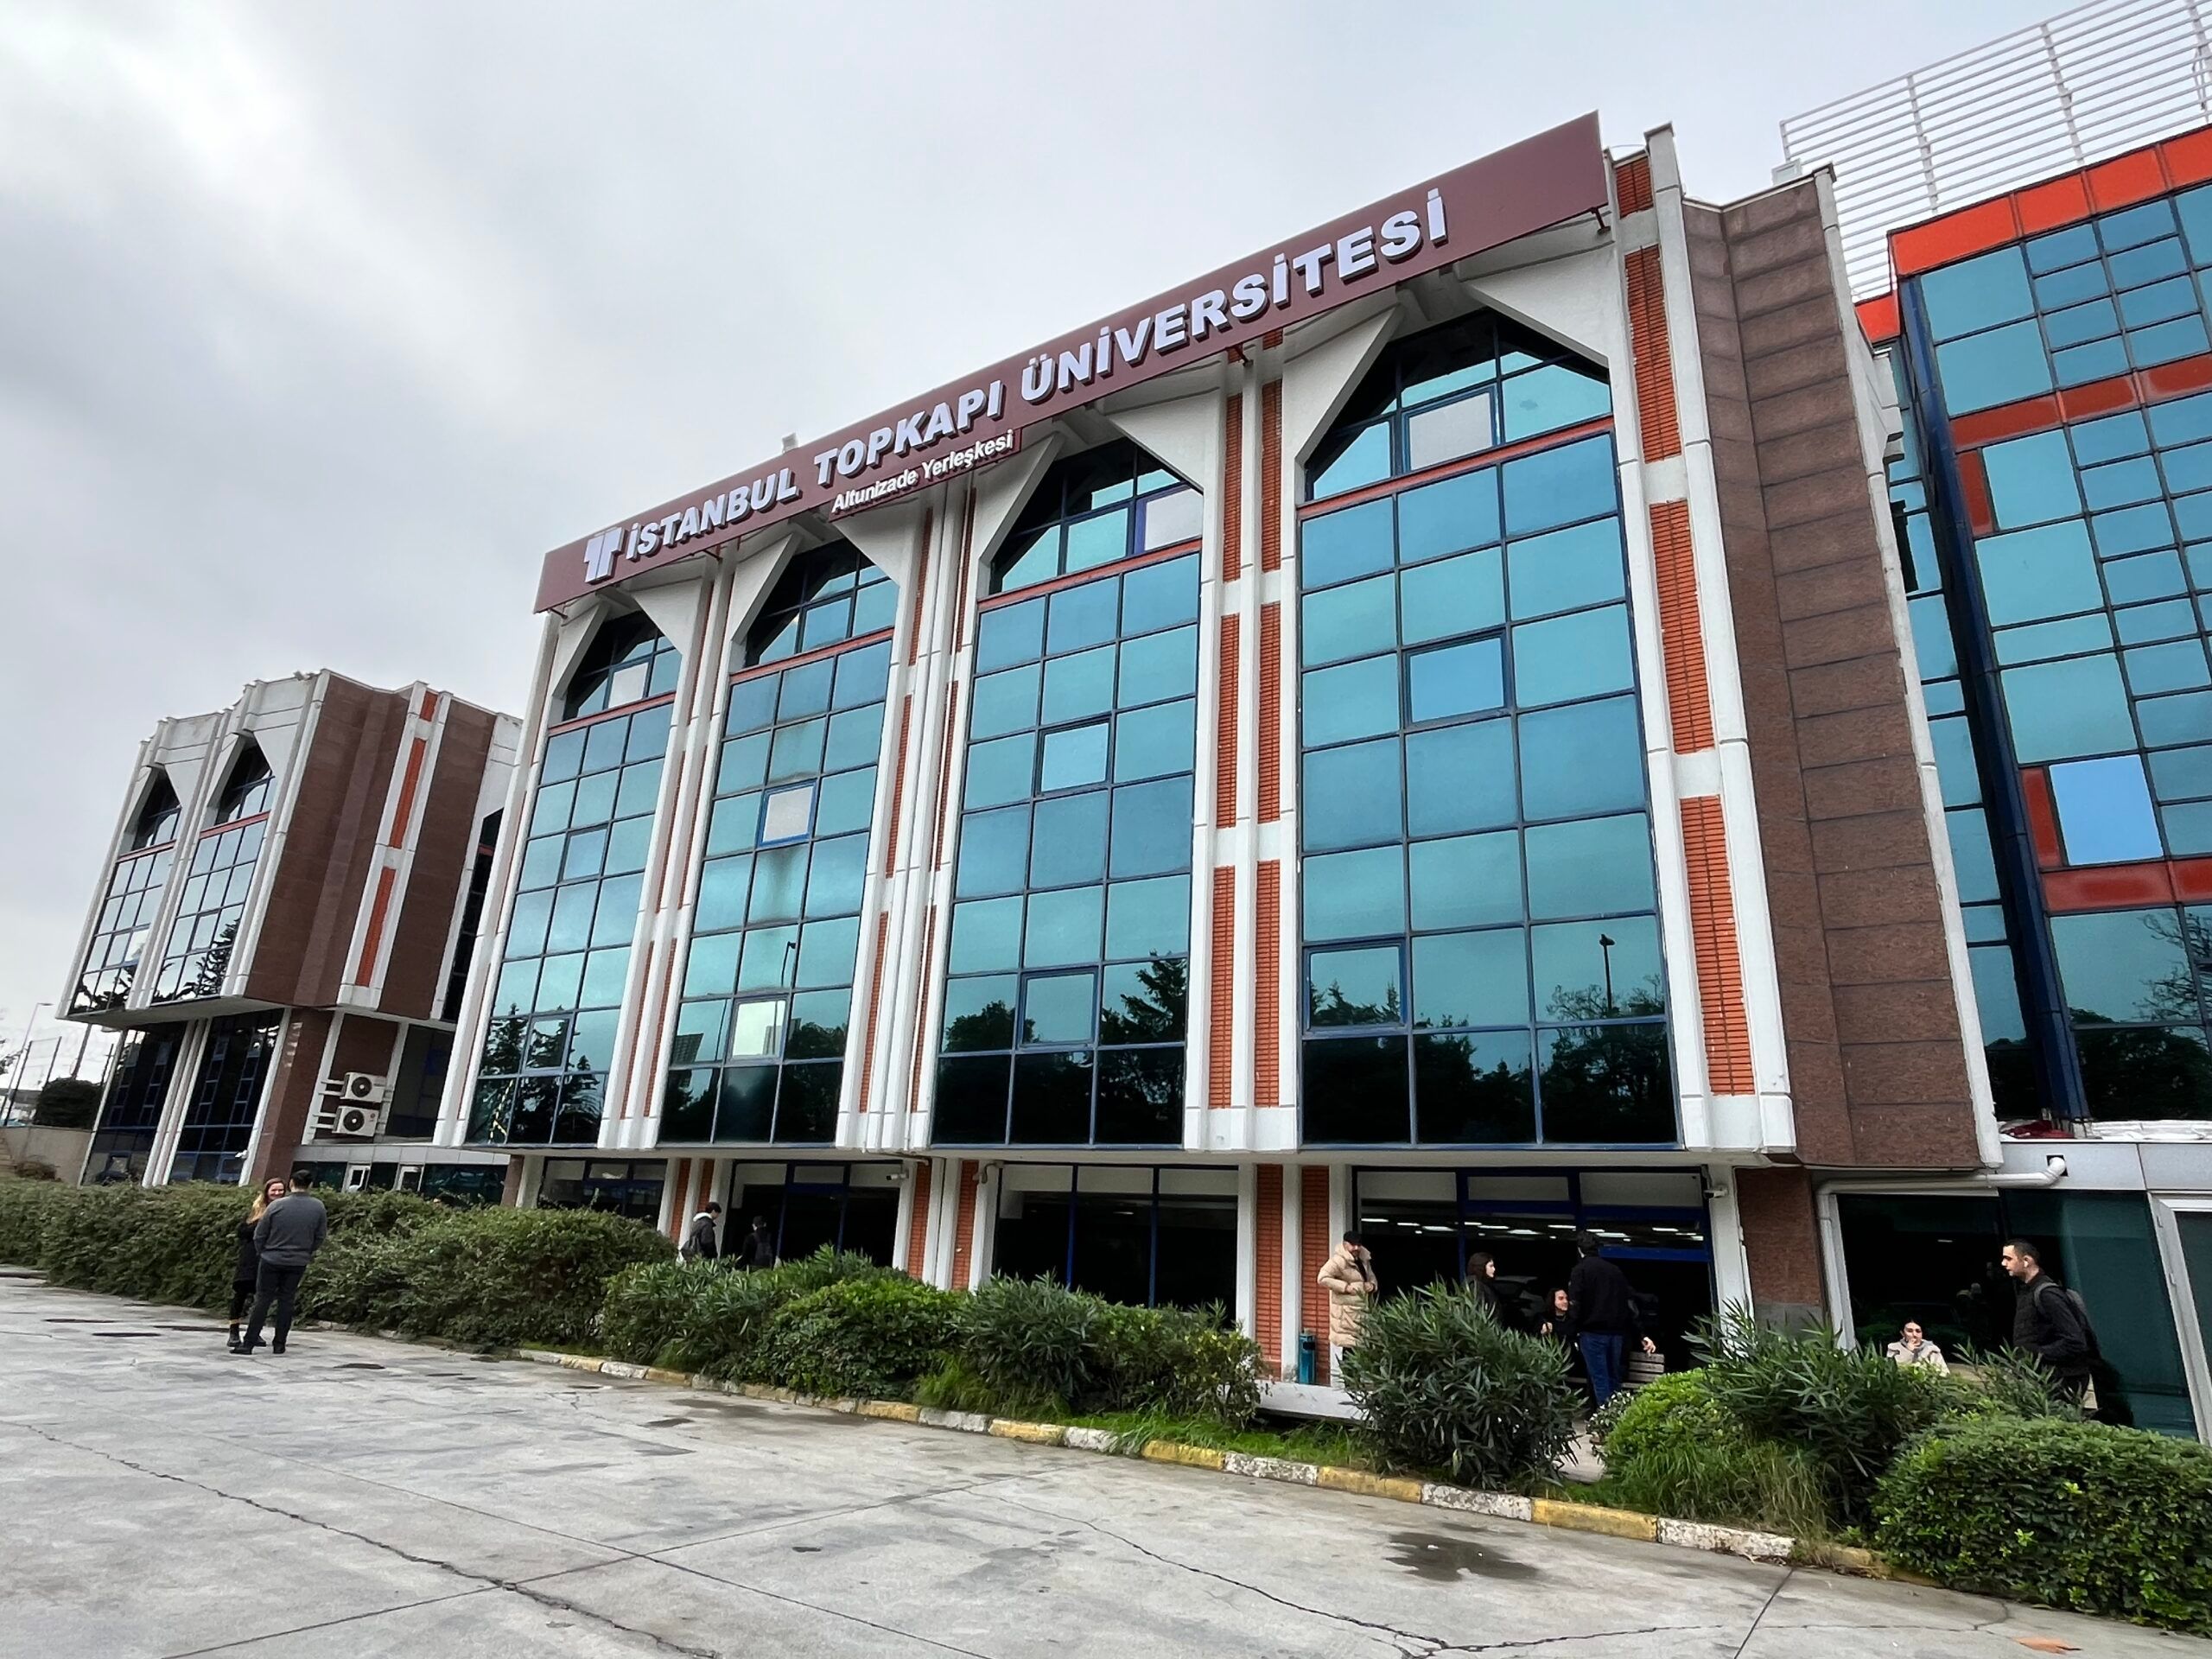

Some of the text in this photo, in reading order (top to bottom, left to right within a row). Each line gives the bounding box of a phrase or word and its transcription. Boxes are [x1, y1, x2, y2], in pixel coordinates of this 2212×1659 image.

[626, 467, 799, 561] İSTANBUL
[814, 379, 1004, 486] TOPKAPI
[1021, 188, 1447, 403] ÜNİVERSİTESİ
[831, 429, 1016, 513] Altunizade Yerleşkesi
